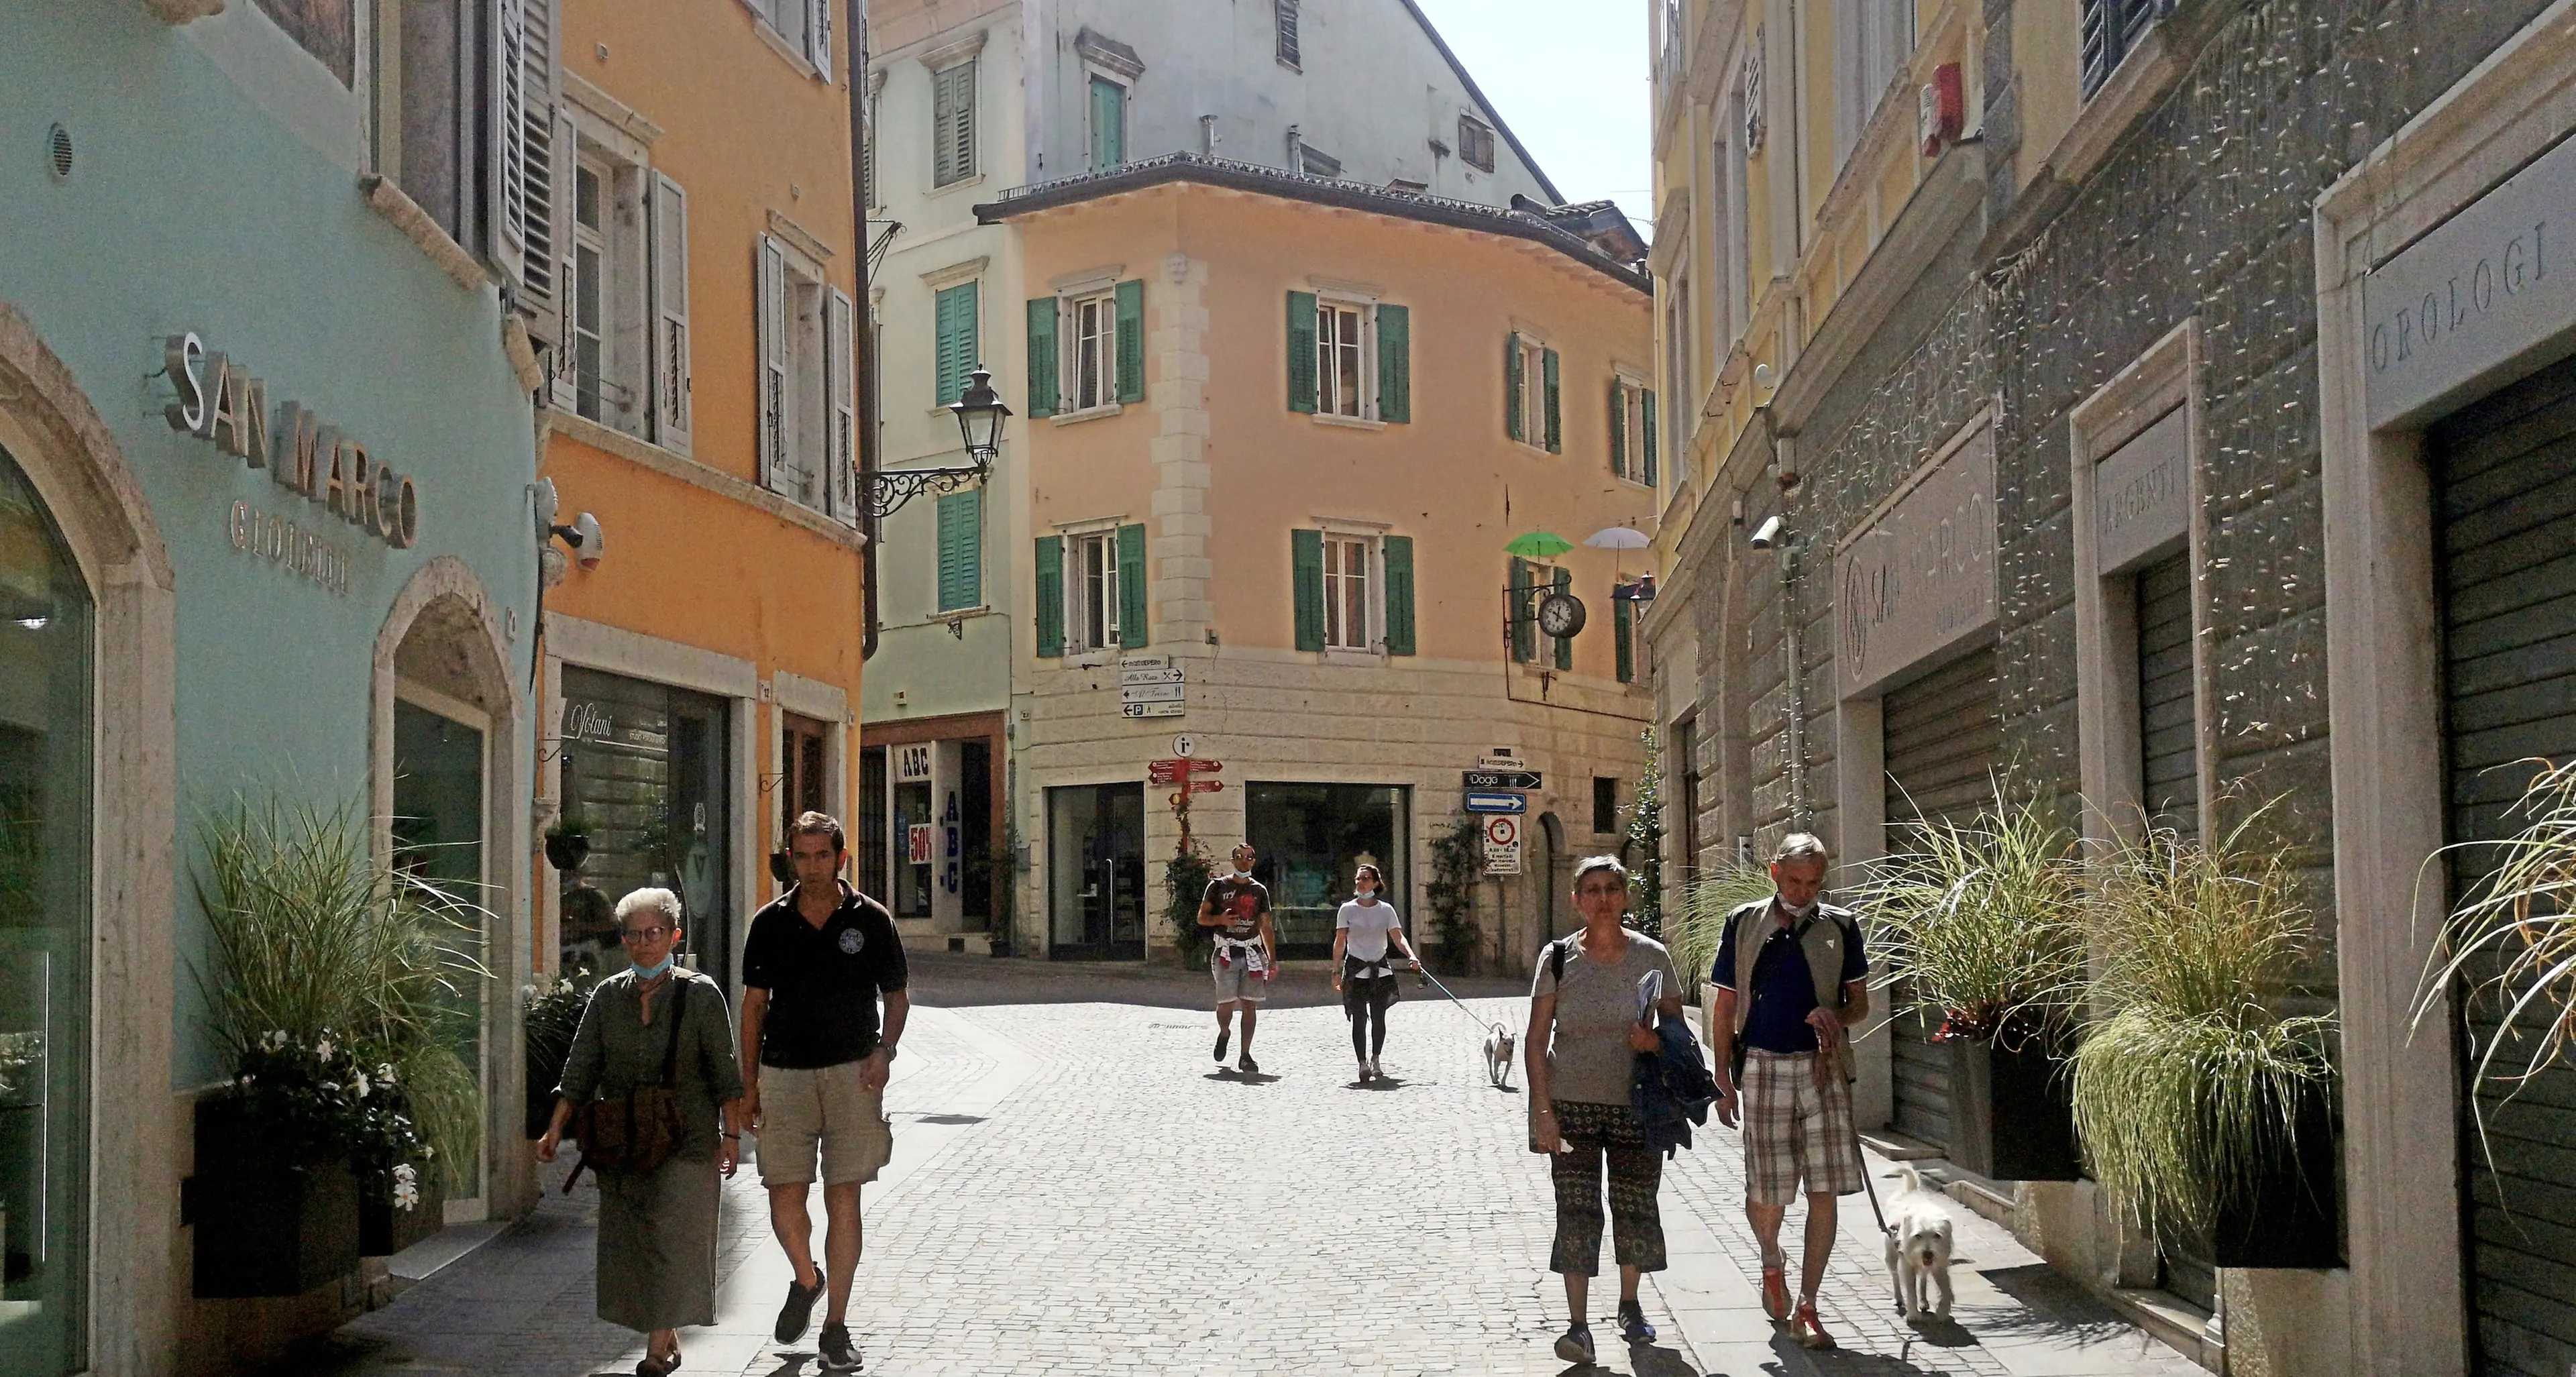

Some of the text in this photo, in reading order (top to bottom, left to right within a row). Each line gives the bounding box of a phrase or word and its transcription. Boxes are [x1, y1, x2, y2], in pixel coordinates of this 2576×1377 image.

[2373, 221, 2545, 374] OROLOGI
[169, 331, 417, 549] SAN MARCO
[2105, 456, 2176, 534] ARGENTI
[904, 747, 928, 777] ABC
